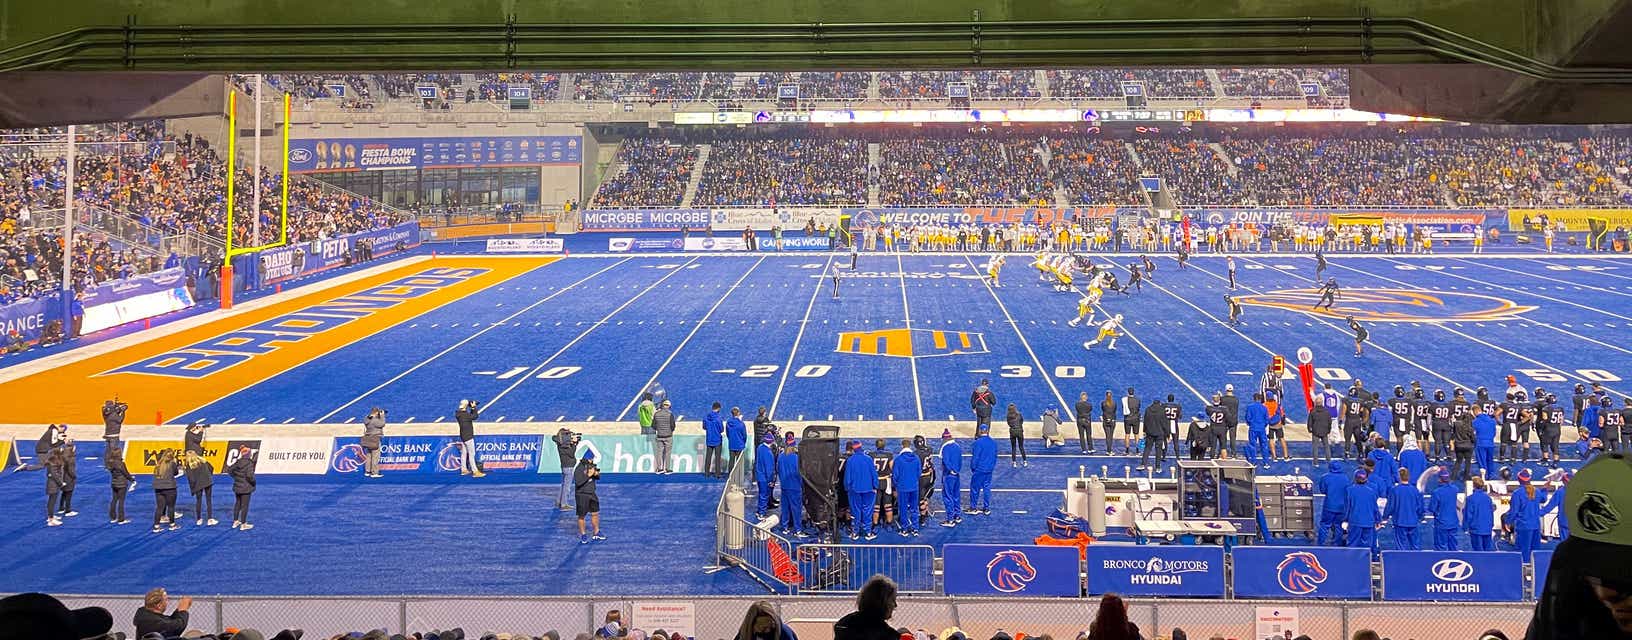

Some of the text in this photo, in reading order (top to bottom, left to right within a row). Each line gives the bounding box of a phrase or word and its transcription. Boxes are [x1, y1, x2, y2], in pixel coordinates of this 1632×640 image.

[290, 150, 308, 161] Ford
[361, 148, 388, 157] FIESTA
[390, 147, 417, 156] BOWL
[360, 156, 411, 165] CHAMPIONS
[585, 213, 643, 223] MICROBE
[650, 212, 708, 223] MICROBE
[884, 213, 949, 223] WELCOME
[953, 213, 971, 223] TO
[1230, 211, 1263, 221] JOIN
[1265, 211, 1292, 221] THE
[762, 238, 800, 248] CAPING
[262, 250, 293, 269] DAHO
[88, 266, 494, 379] BRONCOS
[1273, 356, 1284, 374] 3
[1165, 407, 1178, 419] 25
[1350, 402, 1360, 414] 91
[1395, 402, 1408, 415] 95
[1435, 407, 1449, 419] 98
[1483, 403, 1495, 415] 56
[1210, 411, 1224, 424] 42
[1506, 408, 1519, 420] 21
[1607, 413, 1619, 425] 53
[380, 443, 432, 453] ONS BANK
[475, 442, 537, 451] ZIONS BANK
[226, 448, 259, 466] CT
[268, 452, 326, 460] BUILT FOR YOU.
[612, 442, 705, 473] homi
[873, 457, 888, 472] 57
[1103, 559, 1208, 570] BRONCO MOTORS
[1130, 574, 1182, 585] HYUNDAI
[1426, 583, 1480, 593] HYUNDAI
